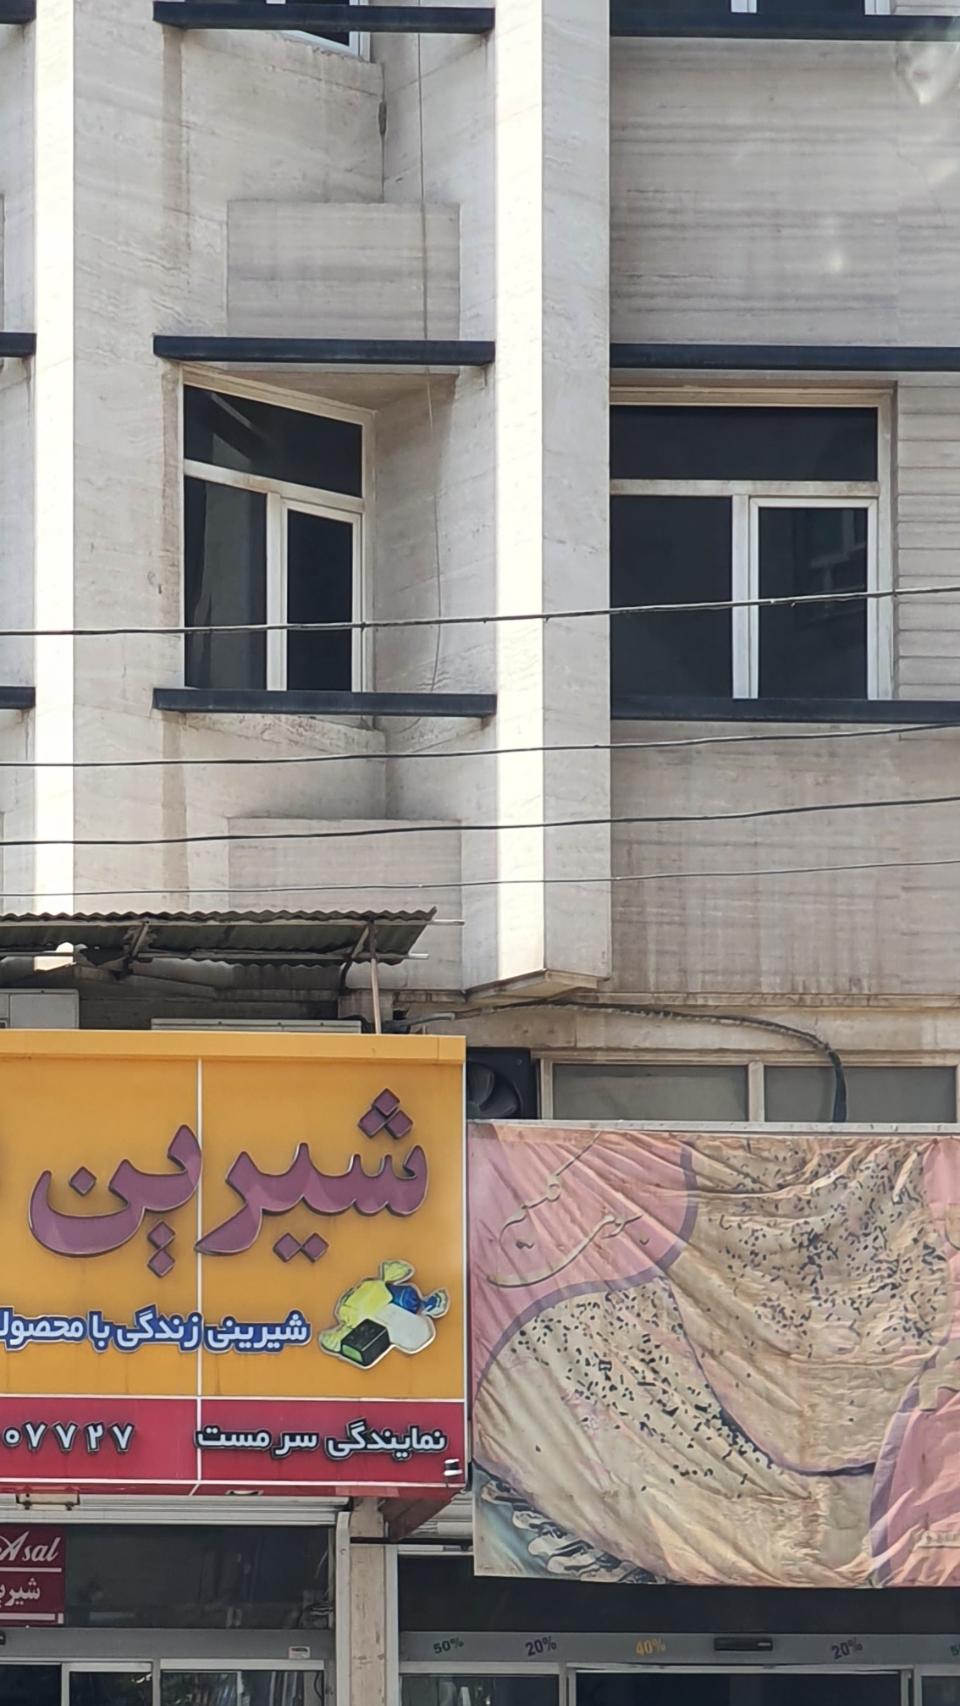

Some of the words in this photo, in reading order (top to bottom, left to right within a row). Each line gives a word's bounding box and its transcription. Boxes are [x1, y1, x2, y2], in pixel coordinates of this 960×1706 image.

[28, 1088, 429, 1278] شیرین
[89, 1312, 113, 1351] با
[115, 1305, 202, 1351] زندگی
[205, 1311, 309, 1351] شیرینی
[327, 1419, 446, 1460] نمایندگی
[433, 1637, 464, 1655] 50%
[524, 1636, 557, 1656] 20%
[635, 1638, 666, 1656] 40%
